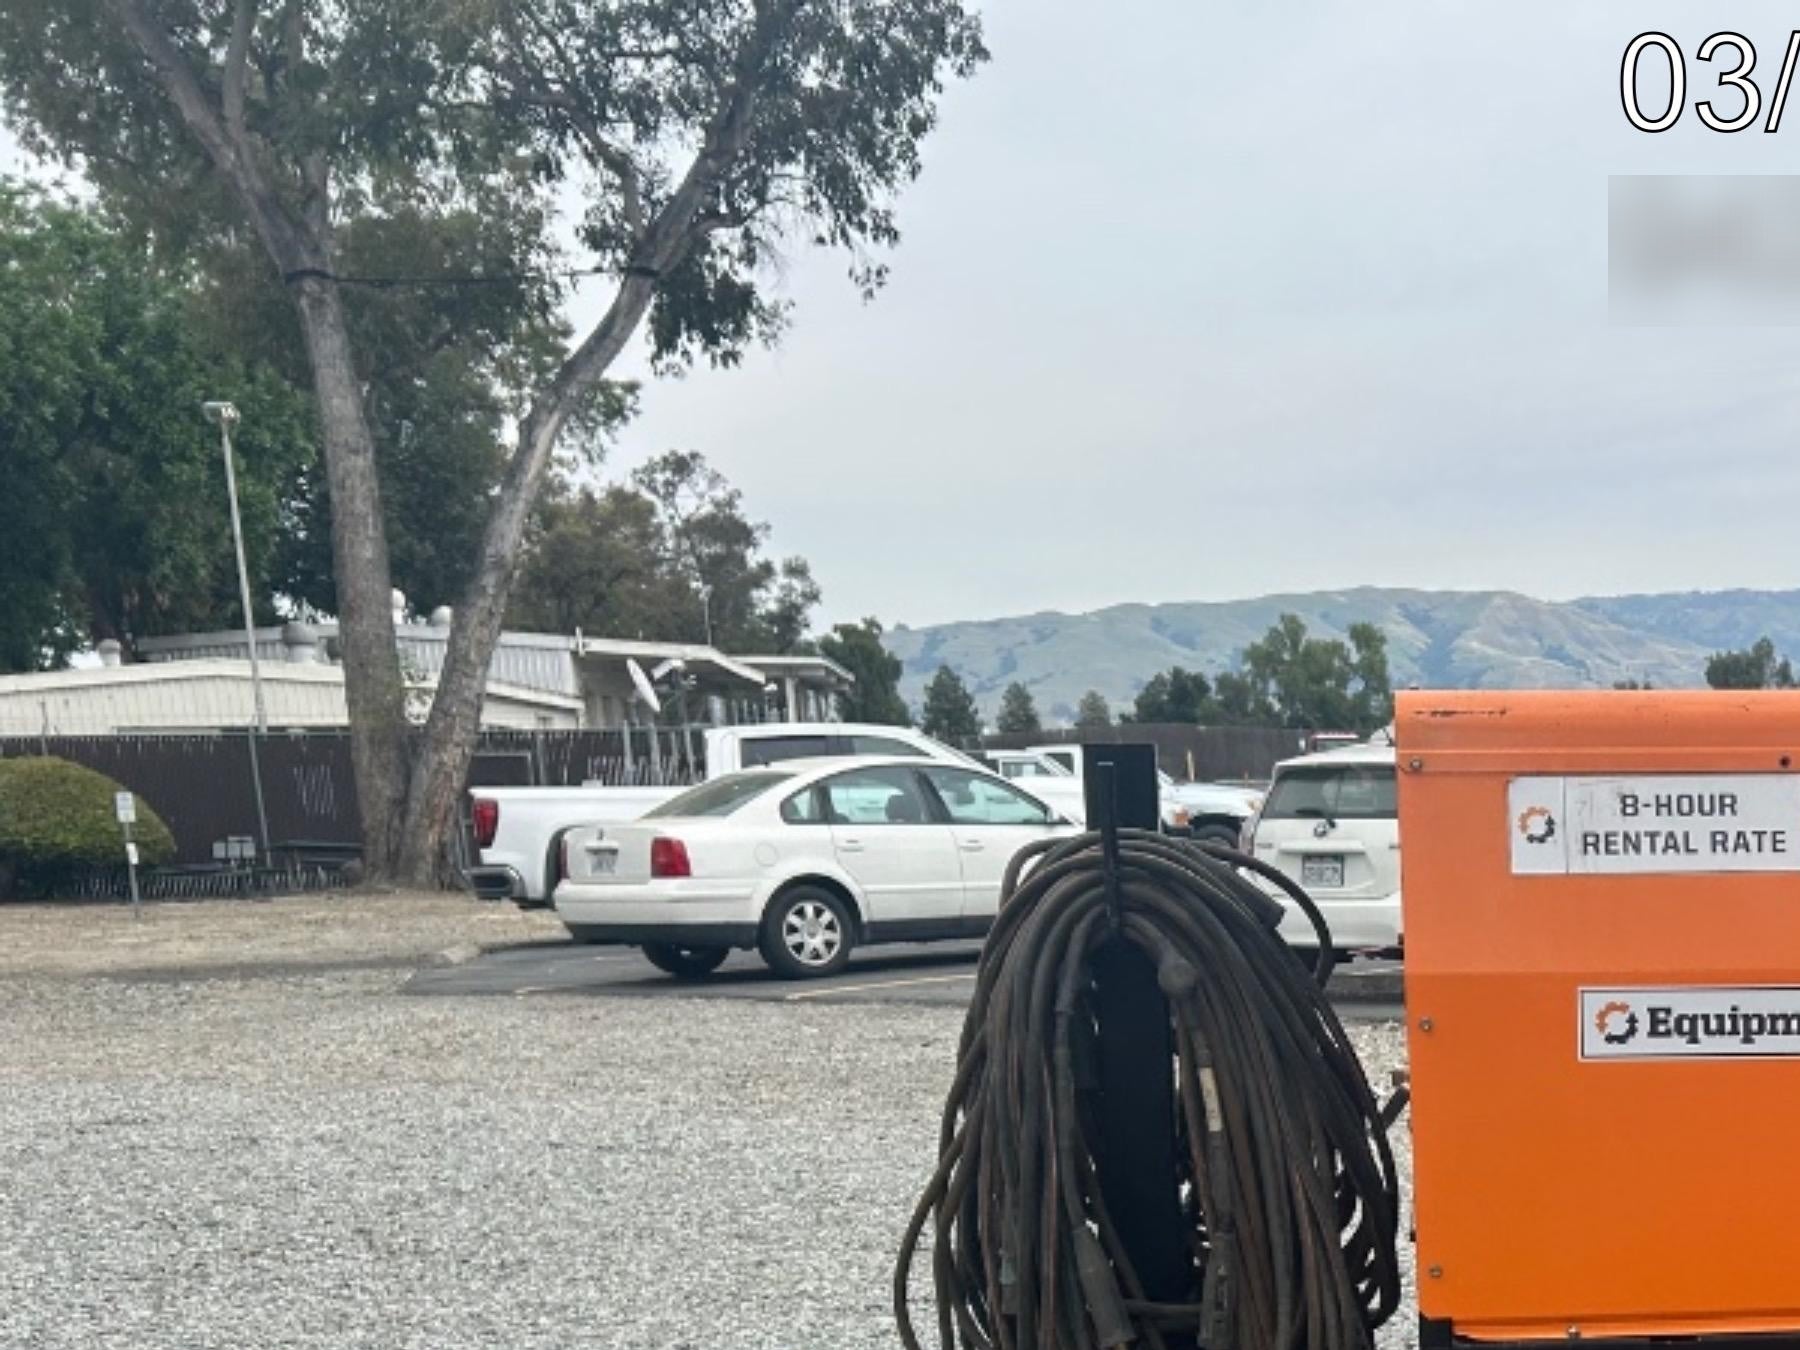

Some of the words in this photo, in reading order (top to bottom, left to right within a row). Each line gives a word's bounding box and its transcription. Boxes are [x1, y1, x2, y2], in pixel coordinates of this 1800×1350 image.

[1619, 793, 1738, 818] 8-HOUR
[1581, 830, 1699, 857] RENTAL
[1709, 830, 1787, 854] RATE
